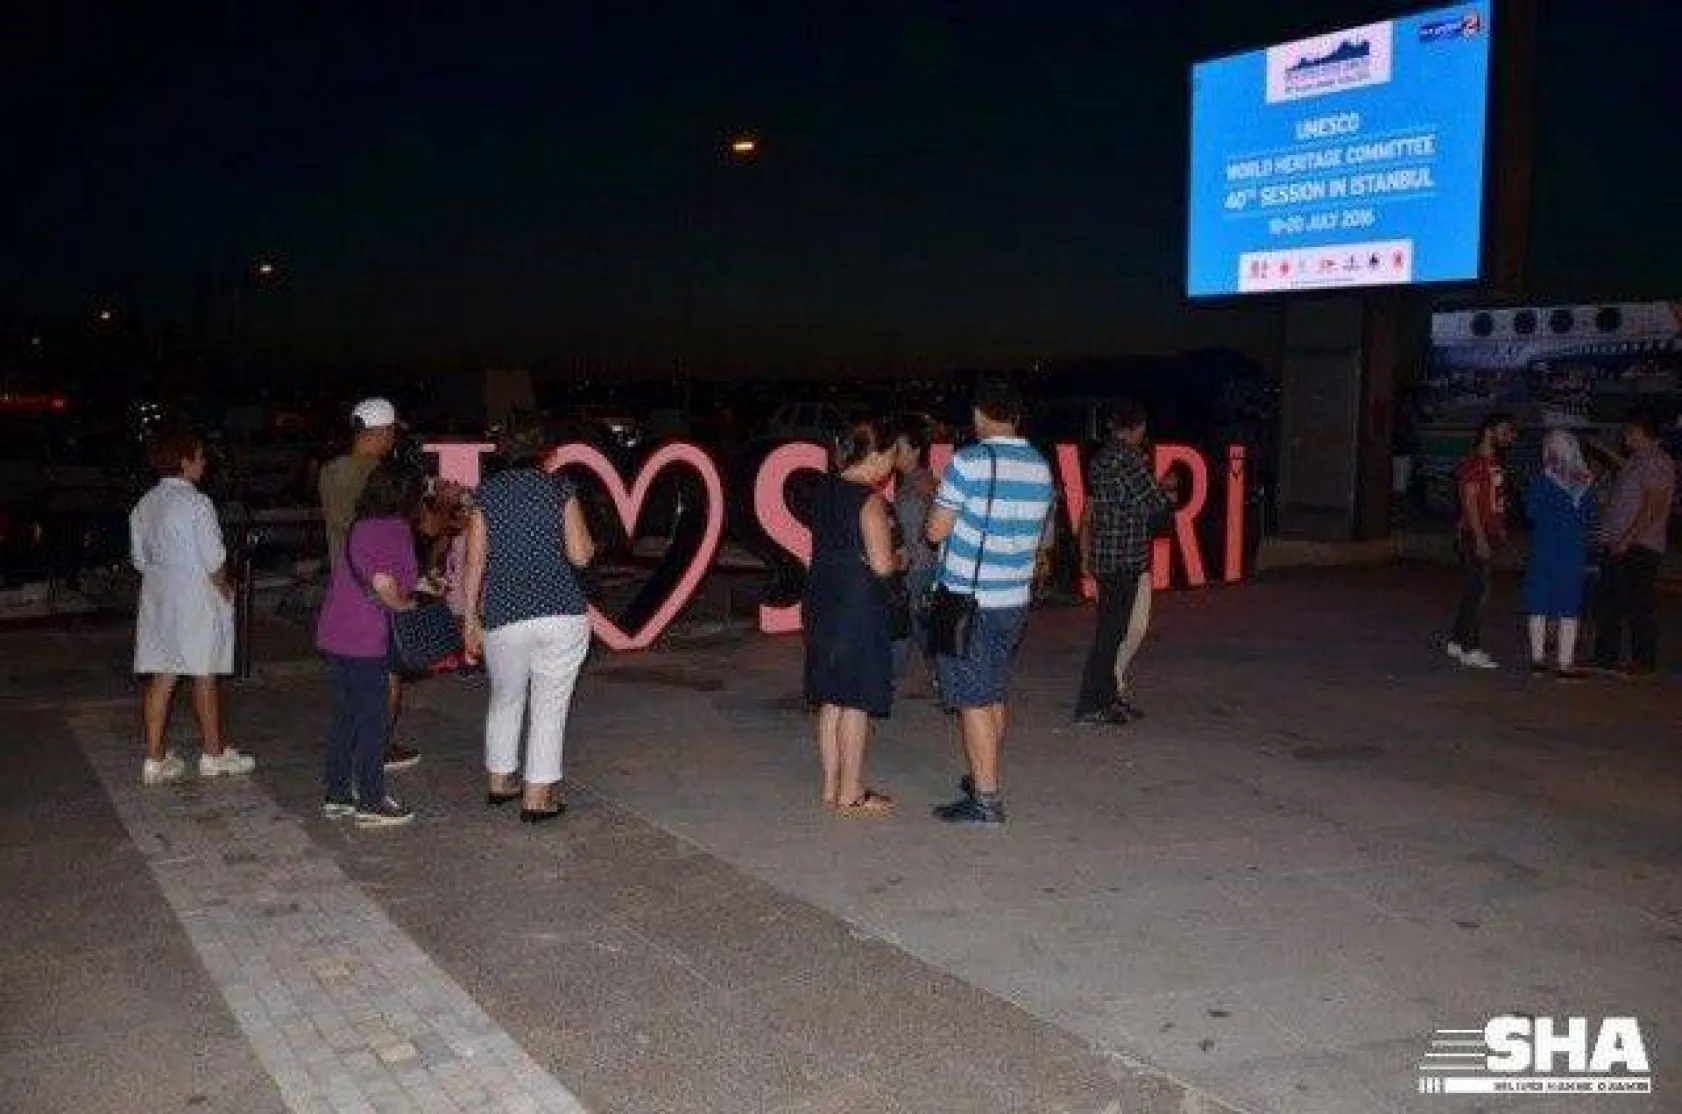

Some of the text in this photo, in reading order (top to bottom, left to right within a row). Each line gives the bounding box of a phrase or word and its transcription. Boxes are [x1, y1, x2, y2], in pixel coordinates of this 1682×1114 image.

[1295, 112, 1360, 140] UNESCO
[1226, 134, 1436, 182] WORLD HERITAGE COMMITTEE
[1260, 181, 1325, 209] SESSION
[1329, 176, 1346, 198] IN
